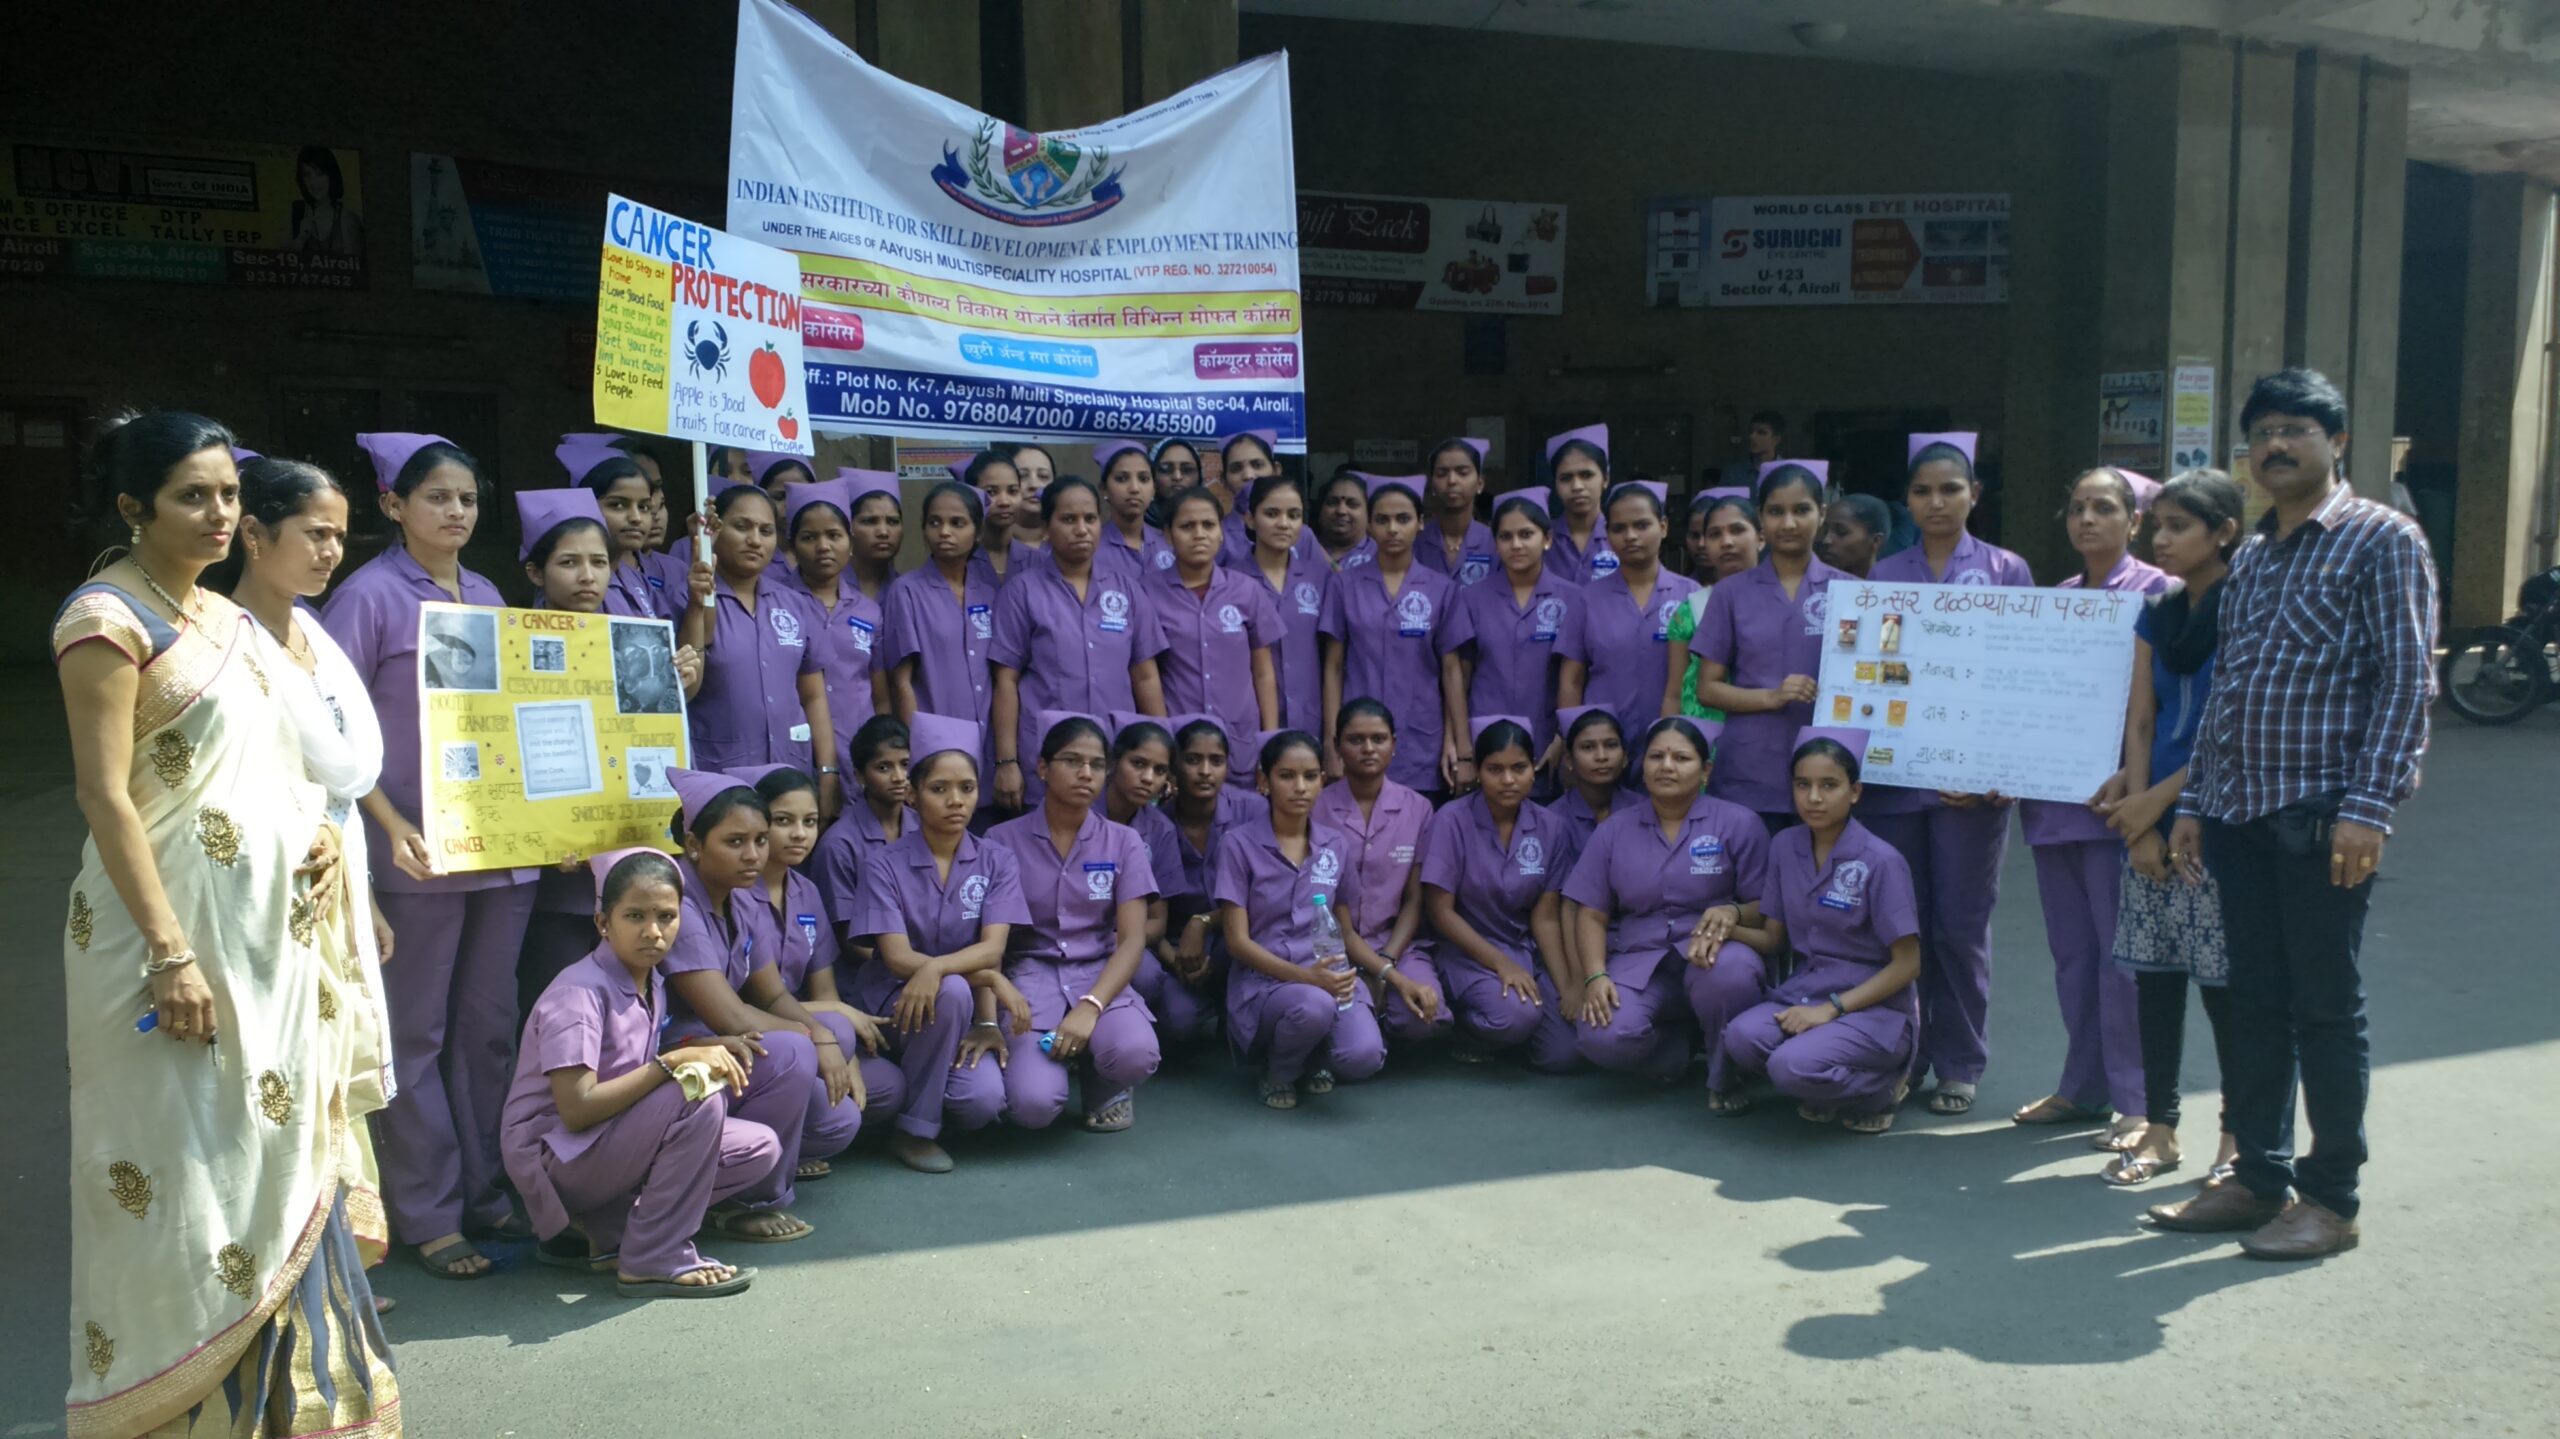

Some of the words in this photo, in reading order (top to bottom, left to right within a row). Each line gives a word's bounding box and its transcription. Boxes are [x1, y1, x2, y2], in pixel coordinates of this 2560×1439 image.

[46, 203, 128, 221] OFFICE
[161, 210, 203, 225] DTP
[1753, 204, 1808, 216] WORLD
[1813, 203, 1863, 215] CLASS
[1869, 200, 1906, 214] EYE
[1913, 199, 2010, 214] HOSPITAL
[737, 178, 799, 206] INDIAN
[803, 189, 885, 227] INSTITUTE
[887, 212, 917, 237] FOR
[921, 221, 967, 247] SKILL
[971, 231, 1091, 260] DEVELOPMENT
[1090, 237, 1102, 257] &
[1106, 231, 1220, 256] EMPLOYMENT
[1223, 231, 1298, 251] TRAINING
[56, 220, 126, 237] EXCEL
[150, 225, 215, 242] TALLY
[223, 230, 262, 244] ERP
[611, 201, 715, 270] CANCER
[1753, 228, 1842, 249] SURUCHI
[233, 250, 303, 271] Sec-19,
[311, 255, 361, 271] Airoli
[762, 220, 802, 236] UNDER
[805, 226, 827, 240] THE
[829, 231, 861, 247] AIGES
[864, 237, 876, 249] OF
[880, 240, 933, 265] AAYUSH
[937, 253, 1056, 284] MULTISPECIALITY
[1060, 267, 1132, 284] HOSPITAL
[1133, 265, 1160, 279] (VTP
[1163, 265, 1189, 277] REG.
[1195, 264, 1215, 277] NO.
[1218, 263, 1277, 277] 327210054)
[1758, 269, 1804, 282] U-123
[671, 261, 802, 333] PROTECTION
[801, 272, 889, 298] सरकारच्या
[896, 282, 950, 312] कौशल्य
[957, 295, 1008, 320] विकास
[1122, 306, 1183, 326] विभिन्न
[1189, 304, 1236, 324] मोफत
[1243, 302, 1292, 323] कोर्सेस
[1721, 283, 1774, 296] Sector
[1799, 282, 1841, 295] Airoli
[803, 315, 856, 341] कोर्सेस
[1255, 347, 1293, 368] कोर्सेस
[605, 366, 626, 380] Love
[628, 371, 639, 384] to
[673, 382, 704, 407] Apple
[709, 390, 718, 408] is
[722, 392, 745, 413] good
[836, 371, 869, 389] Plot
[874, 374, 901, 391] No.
[907, 377, 939, 396] K-7,
[944, 381, 1006, 400] Aayush
[1011, 385, 1049, 402] Multi
[1054, 389, 1127, 411] Speciality
[1131, 396, 1192, 413] Hospital
[1197, 397, 1249, 414] Sec-04,
[1253, 396, 1294, 412] Airoli.
[840, 392, 890, 417] Mob
[898, 396, 936, 419] No.
[944, 400, 1073, 428] 9768047000
[1093, 411, 1216, 435] 8652455900
[732, 422, 766, 441] cancer
[522, 613, 575, 631] CANCER
[507, 676, 573, 696] CERVICAL
[457, 715, 510, 733] CANCER
[446, 836, 484, 855] CANCER
